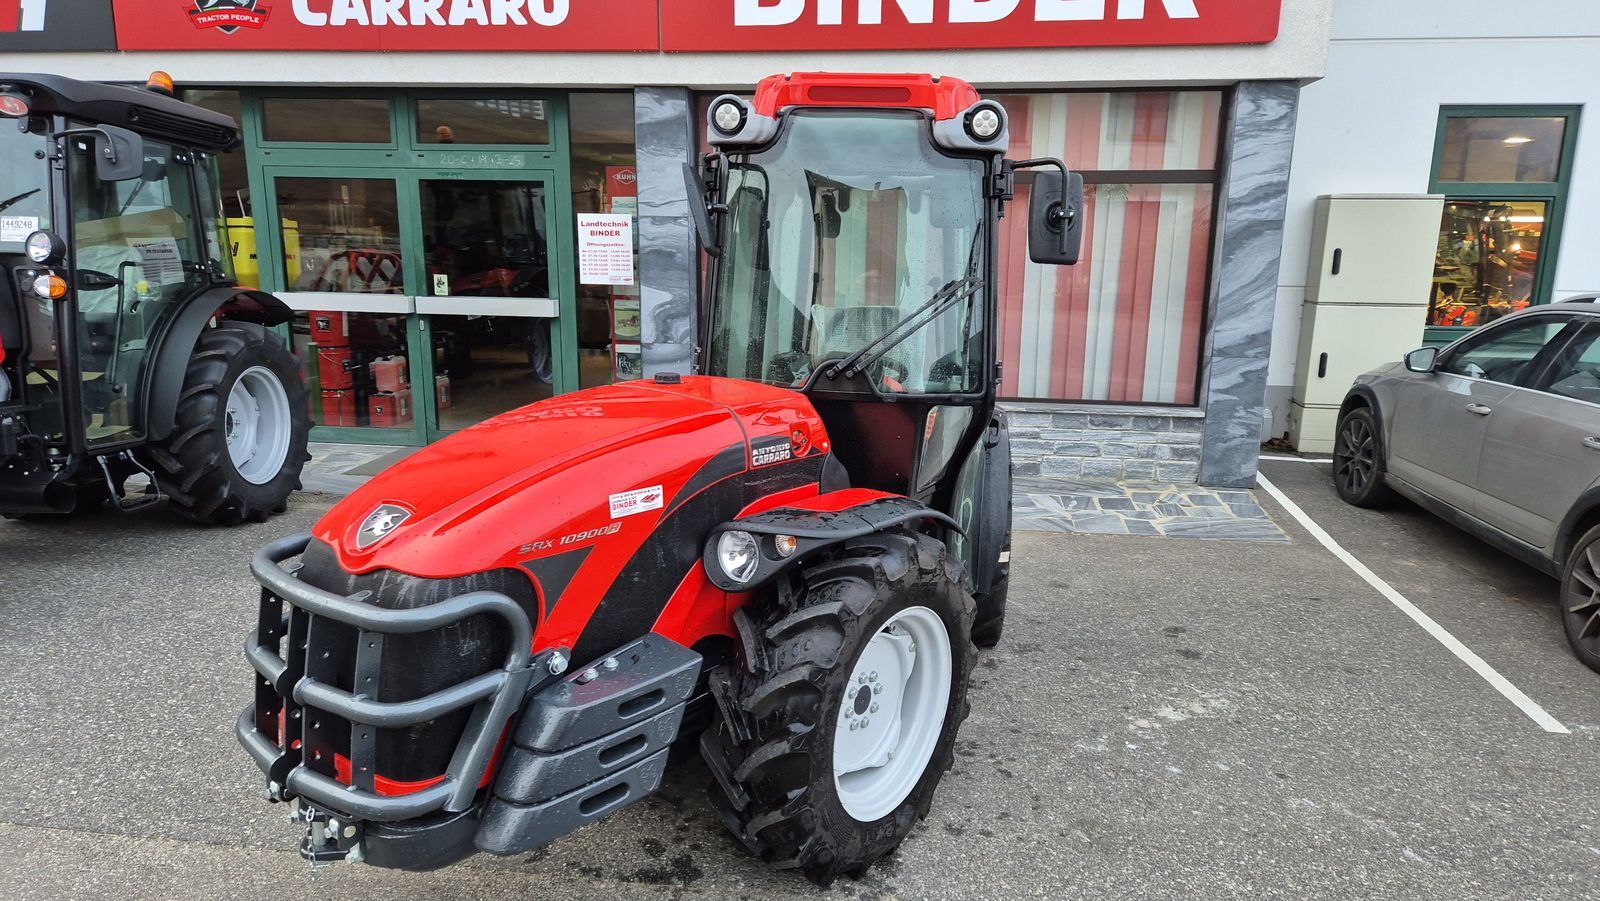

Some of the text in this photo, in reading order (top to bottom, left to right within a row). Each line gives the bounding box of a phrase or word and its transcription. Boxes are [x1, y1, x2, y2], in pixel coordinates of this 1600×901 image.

[197, 13, 259, 24] TRACTOR PEOPLE
[752, 442, 791, 457] ANTONIO
[752, 449, 791, 467] CARRARO
[612, 500, 638, 510] BINDER
[518, 540, 554, 555] SRX
